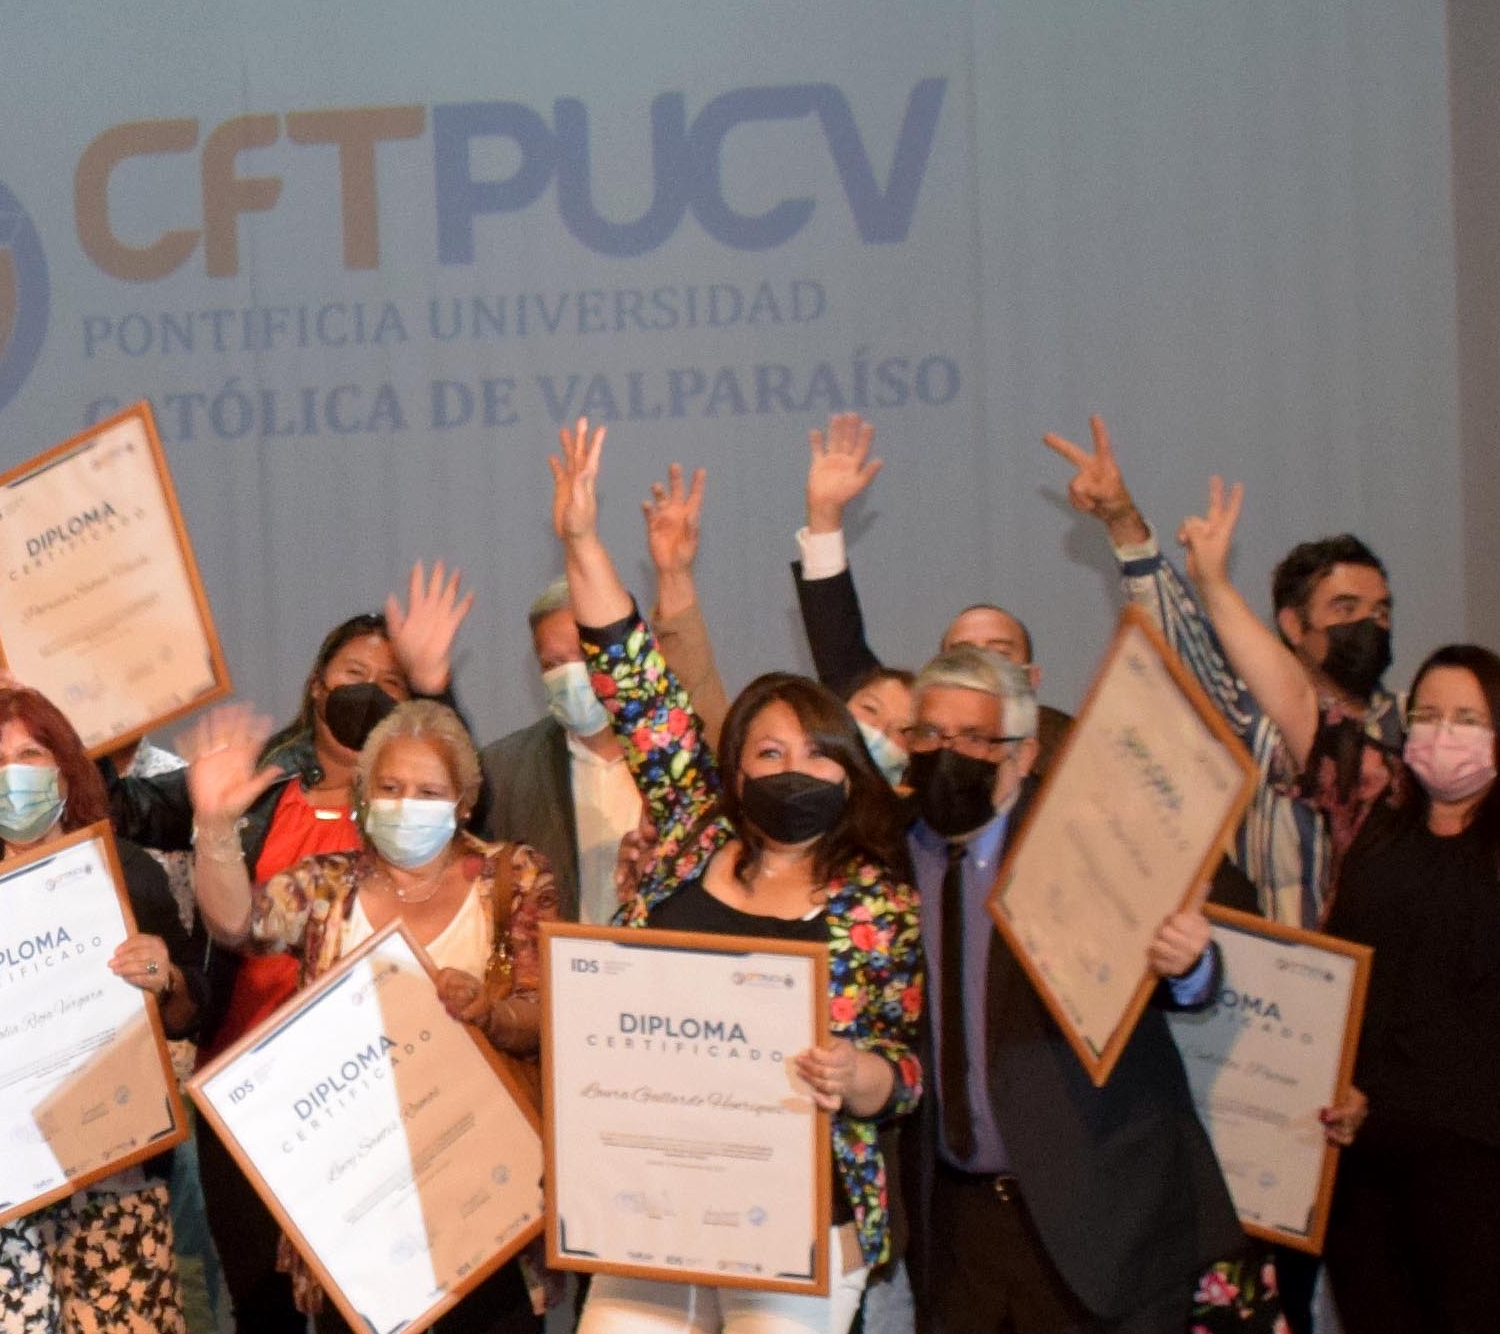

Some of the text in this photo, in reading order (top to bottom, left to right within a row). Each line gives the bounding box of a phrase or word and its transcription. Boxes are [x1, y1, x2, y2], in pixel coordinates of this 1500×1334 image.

[81, 279, 828, 360] PONTIFICIA UNIVERSIDAD
[83, 346, 962, 443] CTÓLICA DE VALPARAÍSO
[26, 500, 117, 558] DIPLOMA
[570, 958, 599, 974] IDS
[586, 1033, 785, 1064] CERTIFICADO
[618, 1013, 748, 1045] DIPLOMA
[228, 1078, 255, 1106] IDS
[291, 1033, 397, 1121] DIPLOMA
